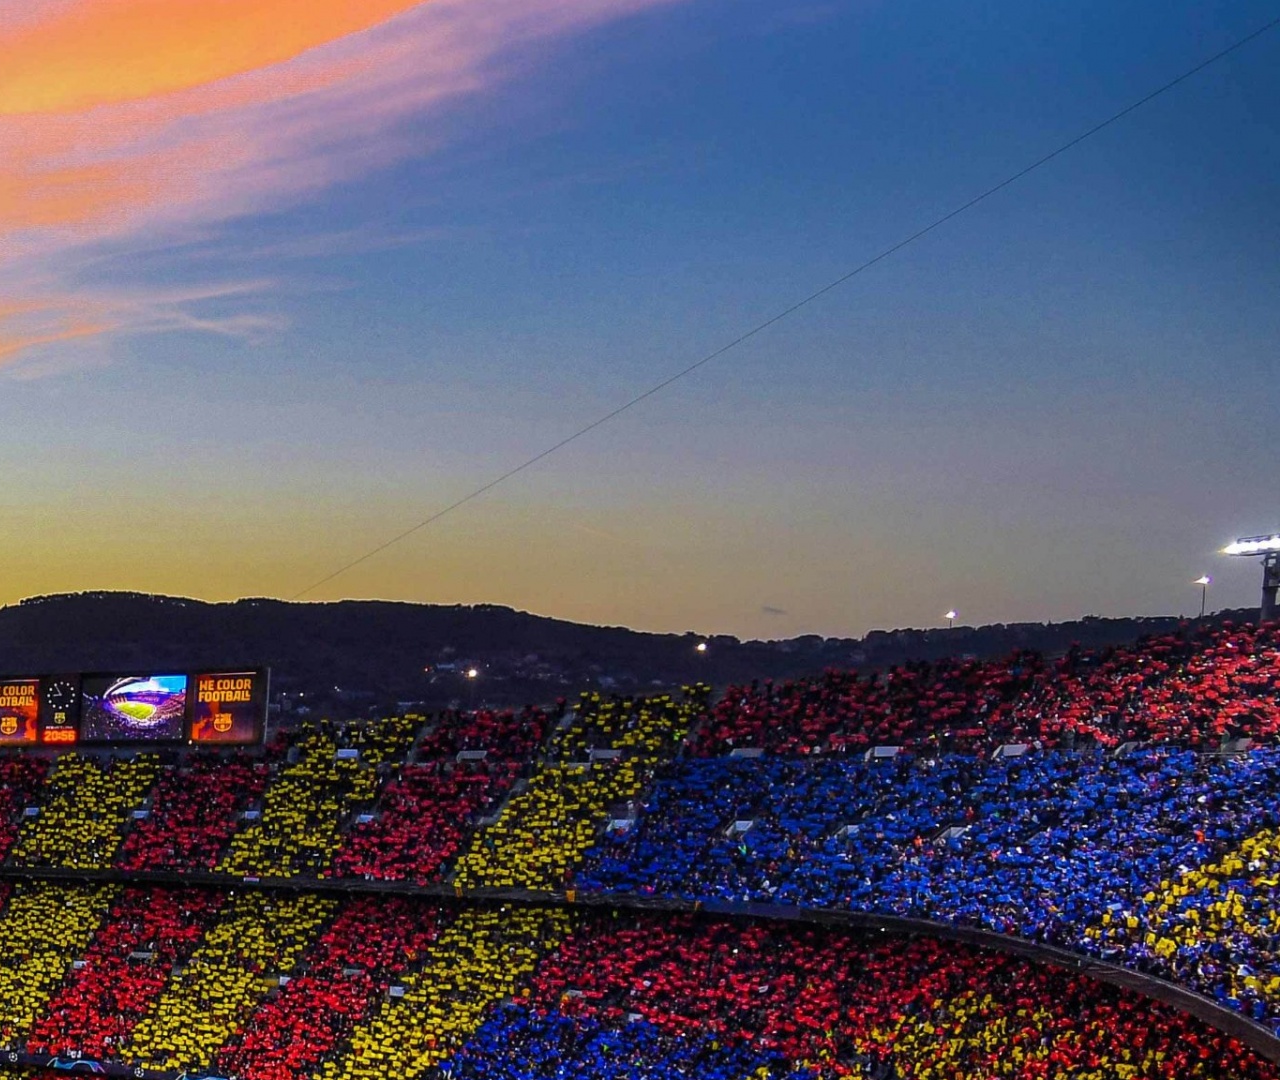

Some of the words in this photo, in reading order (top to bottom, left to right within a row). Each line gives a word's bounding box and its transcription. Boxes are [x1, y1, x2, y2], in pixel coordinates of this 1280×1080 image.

[3, 685, 35, 696] COLOR
[199, 680, 215, 691] WE
[217, 679, 252, 690] COLOR
[198, 690, 251, 703] FOOTBALL
[43, 730, 76, 742] 20:56
